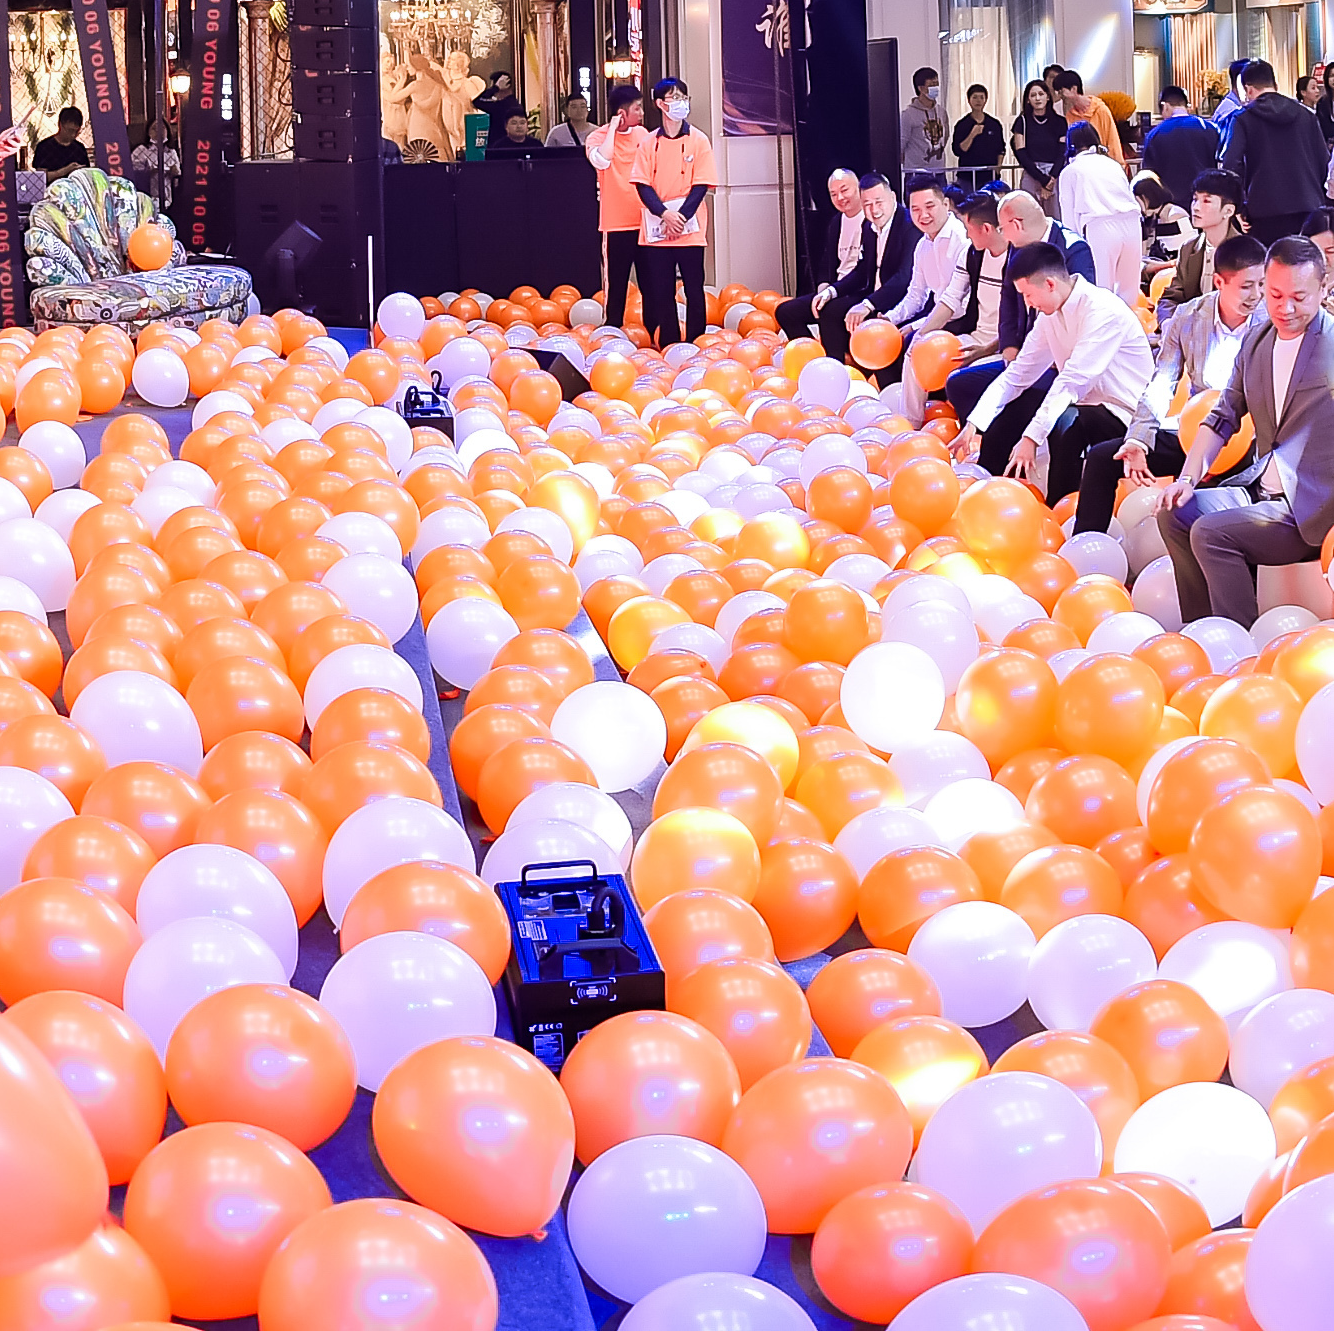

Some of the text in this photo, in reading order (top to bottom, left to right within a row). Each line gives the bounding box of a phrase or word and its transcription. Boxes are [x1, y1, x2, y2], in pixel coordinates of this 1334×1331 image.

[84, 10, 100, 35] 06
[206, 8, 221, 33] 06
[89, 40, 113, 114] YOUNG
[200, 38, 218, 110] YOUNG
[105, 142, 125, 177] 202
[192, 139, 211, 246] 2021 10 06
